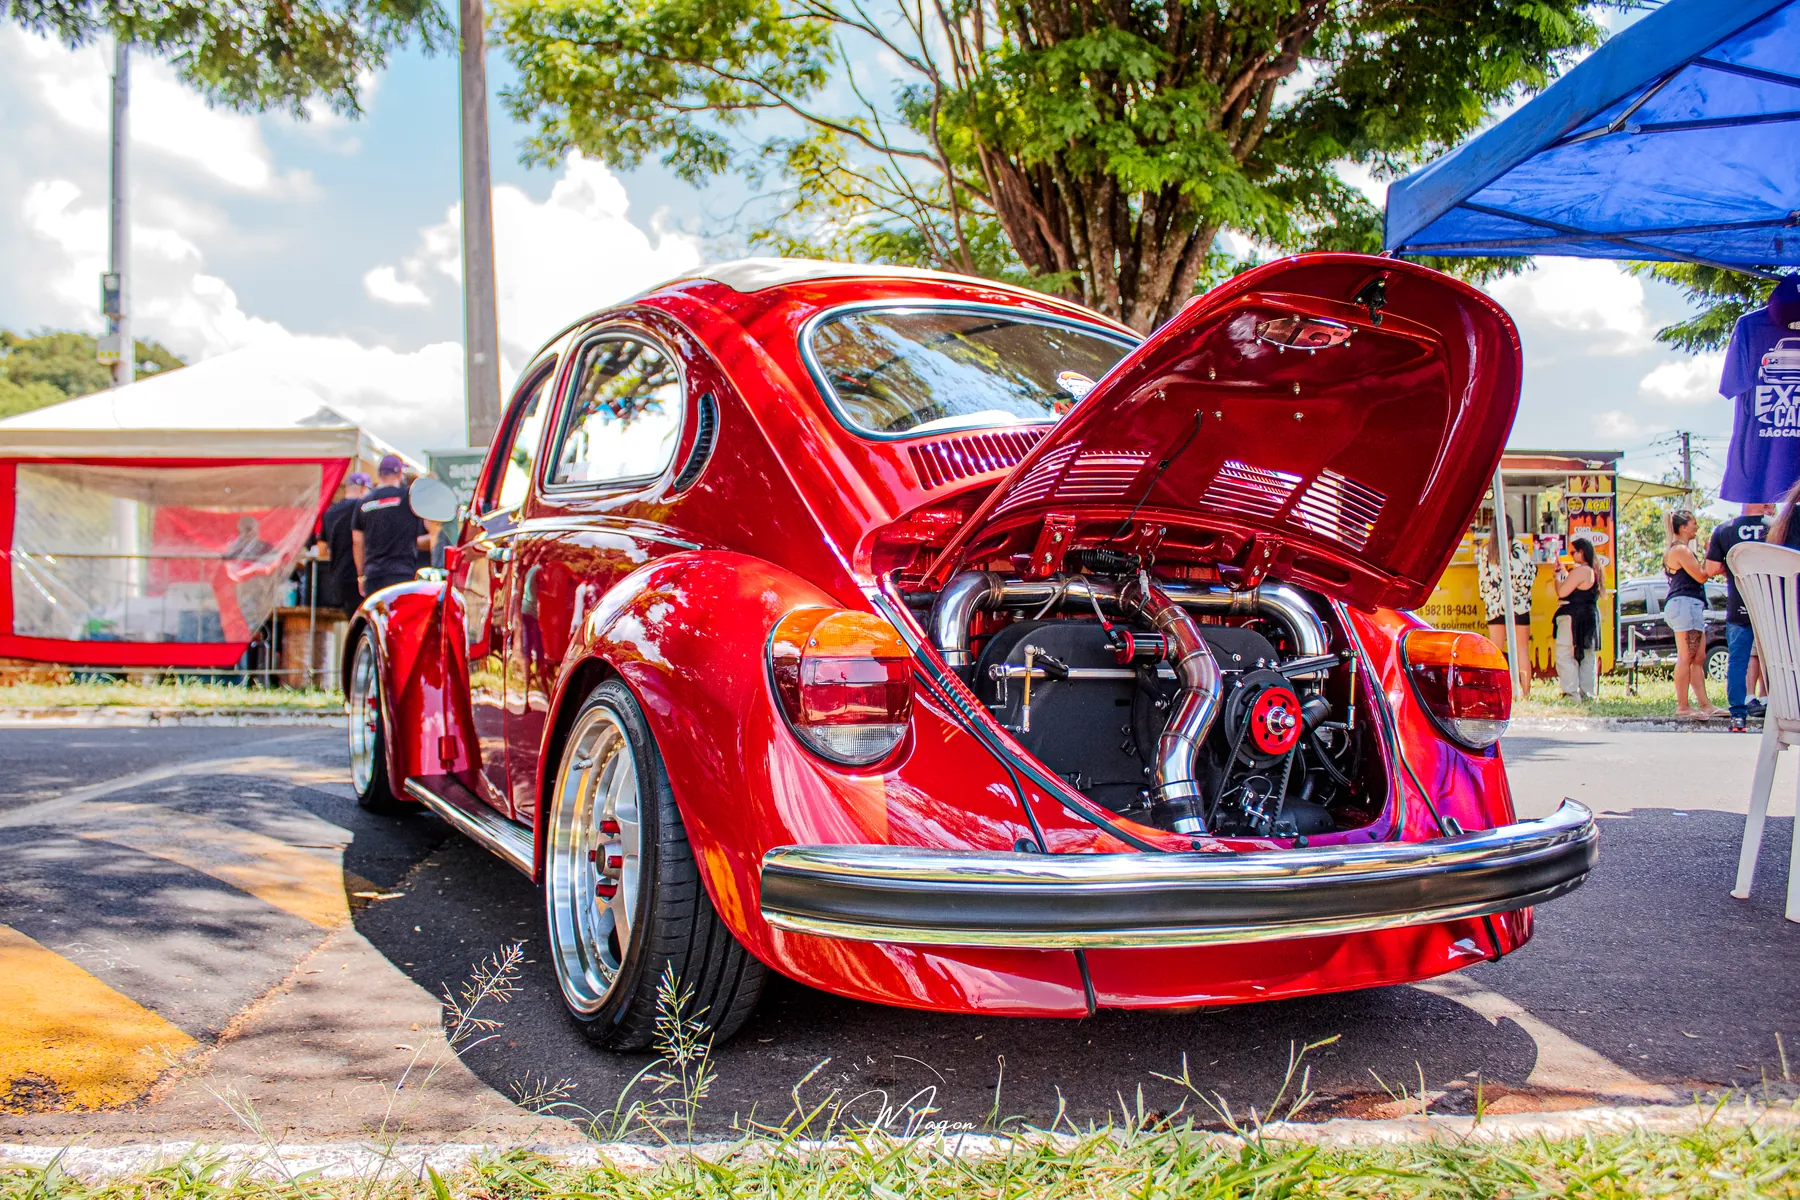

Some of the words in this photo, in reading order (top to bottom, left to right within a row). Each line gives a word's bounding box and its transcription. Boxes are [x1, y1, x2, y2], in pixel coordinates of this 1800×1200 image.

[1738, 525, 1763, 540] CT
[1425, 604, 1478, 616] 98218-9434
[1441, 622, 1475, 630] gourmet
